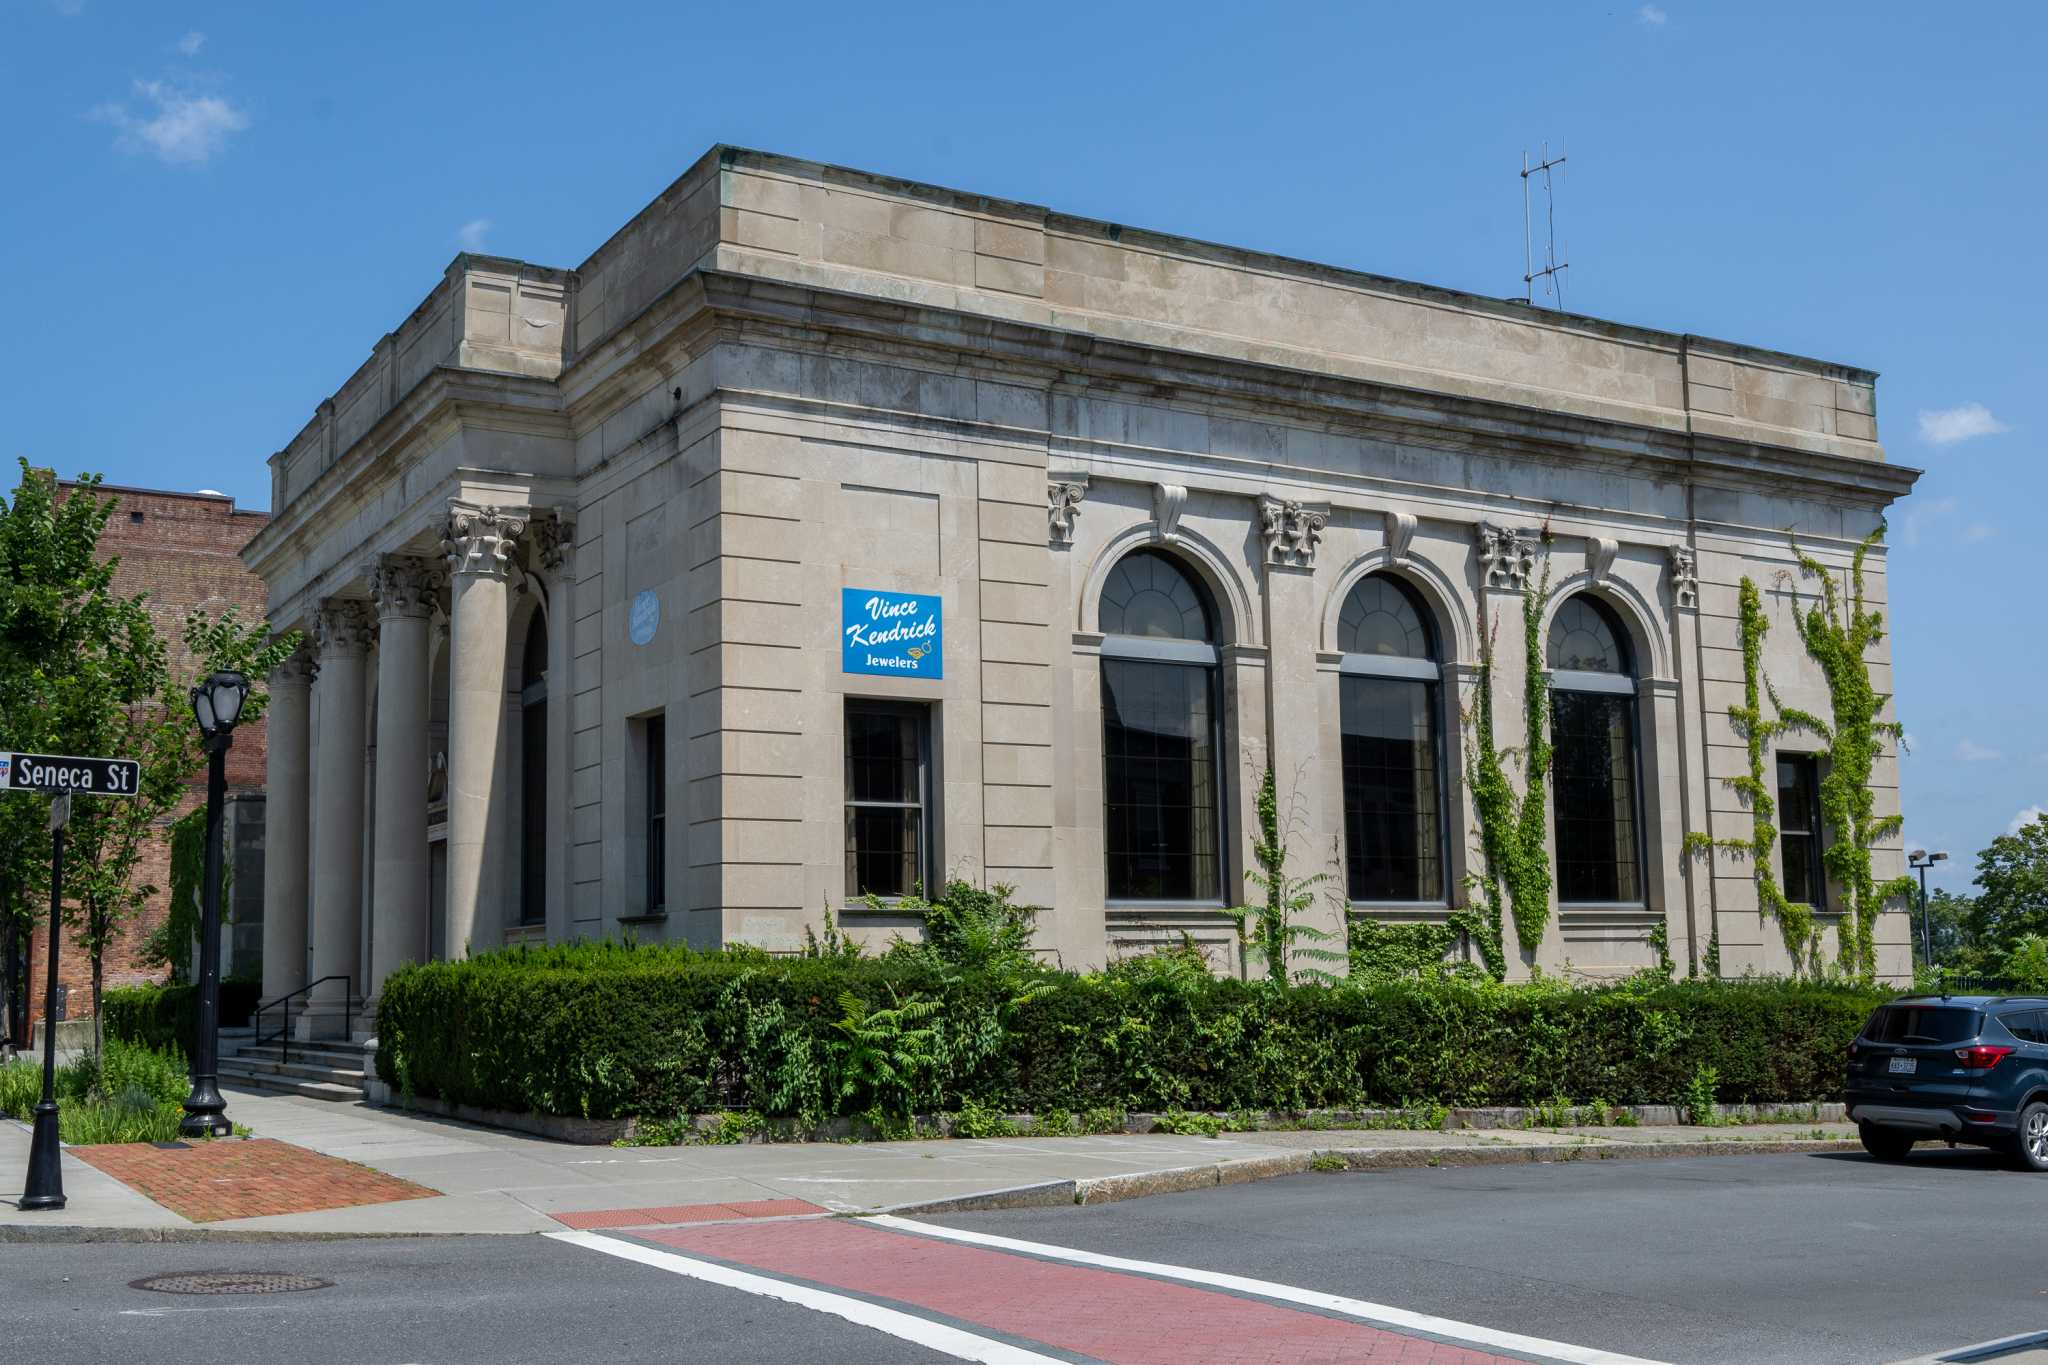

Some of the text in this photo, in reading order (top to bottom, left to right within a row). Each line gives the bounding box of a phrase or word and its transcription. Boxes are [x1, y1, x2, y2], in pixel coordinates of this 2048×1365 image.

[865, 597, 918, 621] Vince
[846, 614, 936, 648] Kendrick
[865, 654, 918, 669] Jewelers
[19, 758, 129, 790] Seneca St
